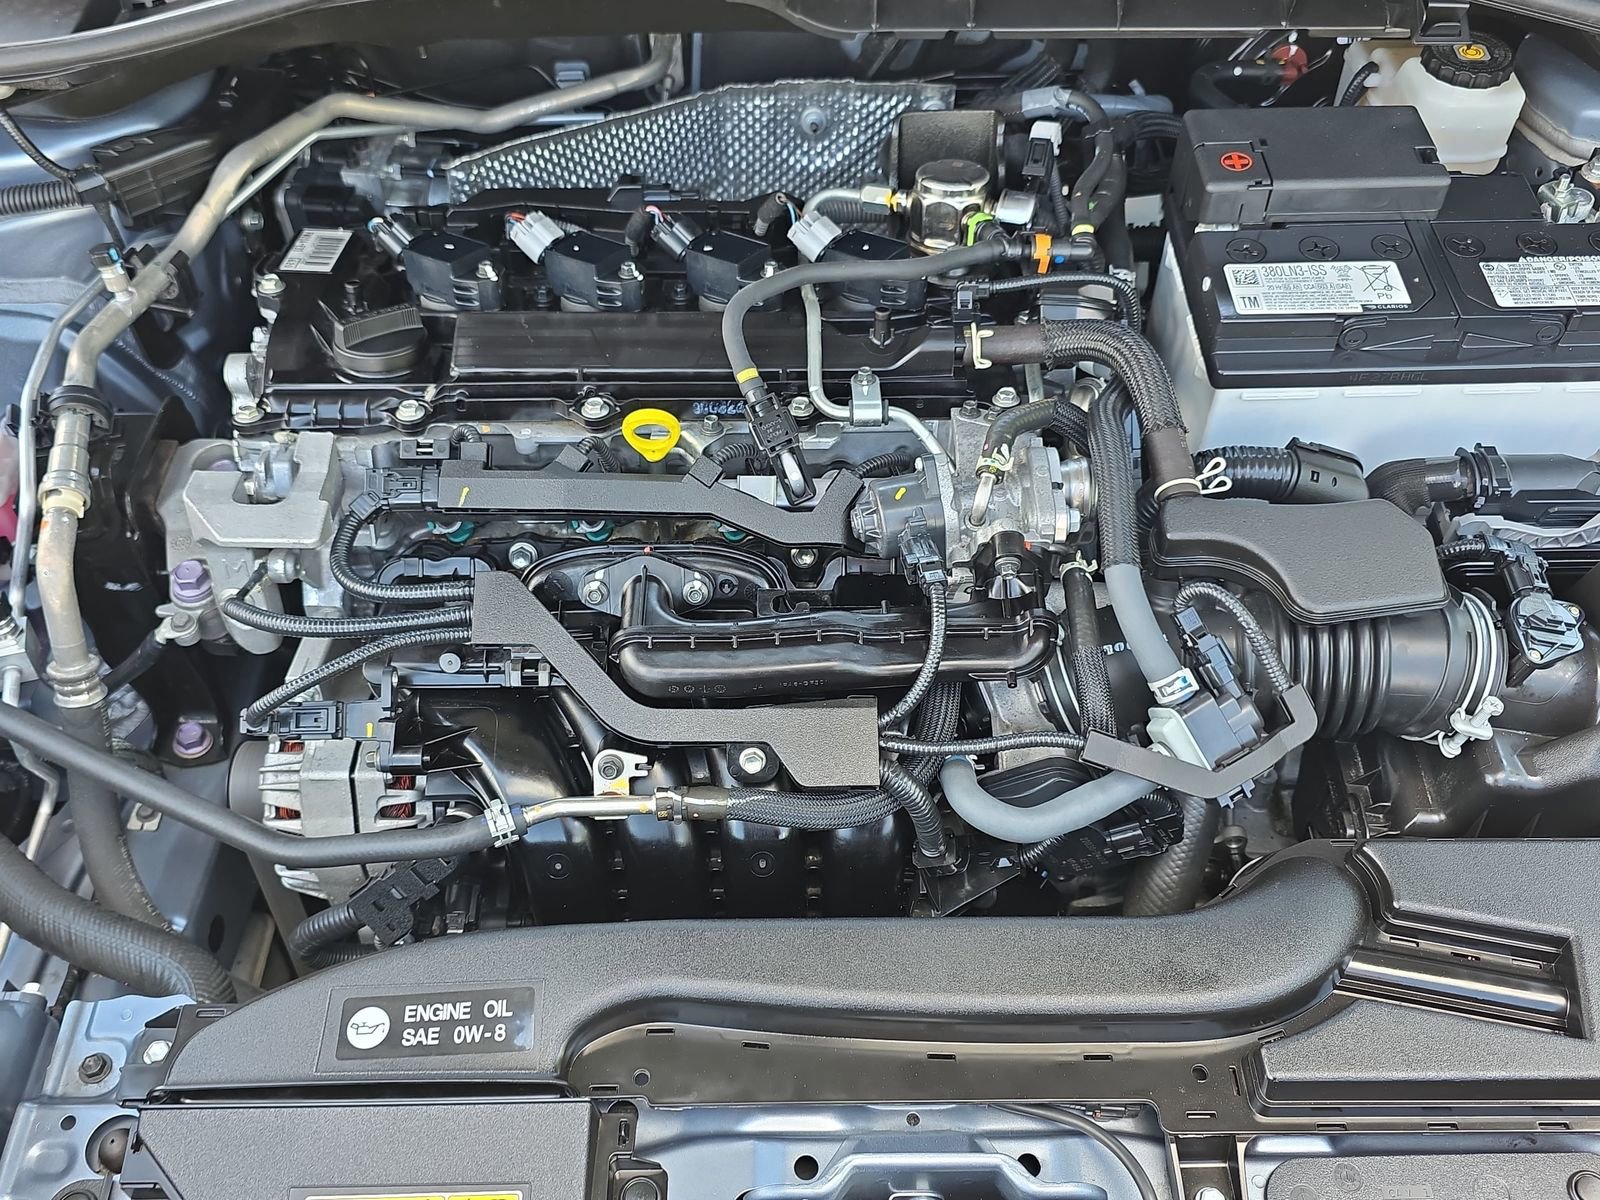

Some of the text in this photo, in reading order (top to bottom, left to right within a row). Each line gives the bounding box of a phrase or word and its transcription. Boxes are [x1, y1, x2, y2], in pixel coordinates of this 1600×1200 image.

[1262, 264, 1327, 278] 380LN3-ISS
[1239, 297, 1260, 308] TM
[1377, 292, 1393, 300] Pb
[404, 1000, 512, 1022] ENGINE OIL
[402, 1024, 506, 1046] SAE 0W-8
